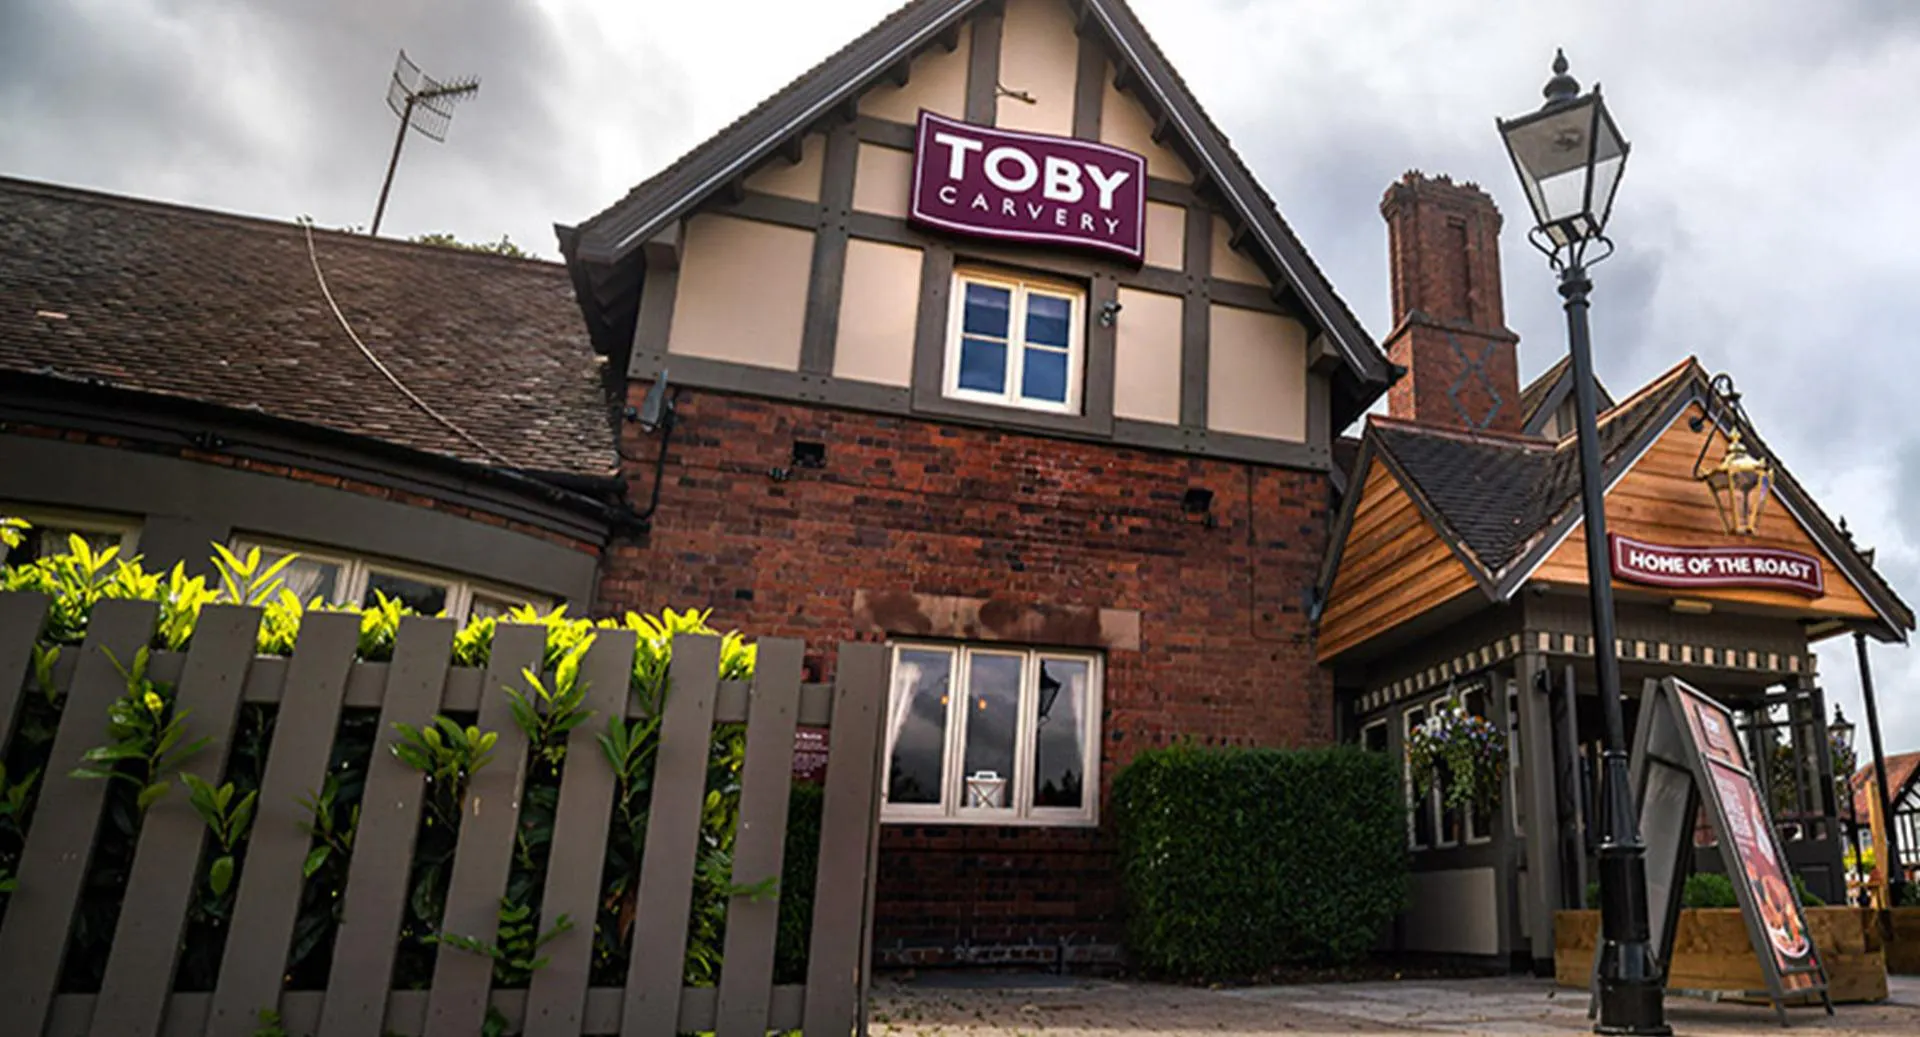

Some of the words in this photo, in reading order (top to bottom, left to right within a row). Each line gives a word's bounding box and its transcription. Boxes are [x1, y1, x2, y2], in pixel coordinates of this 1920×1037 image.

[935, 132, 1130, 211] TOBY
[939, 186, 1120, 234] CARVERY
[1629, 550, 1685, 574] HOME
[1688, 557, 1713, 574] OF
[1714, 558, 1751, 574] THE
[1753, 559, 1811, 579] ROAST
